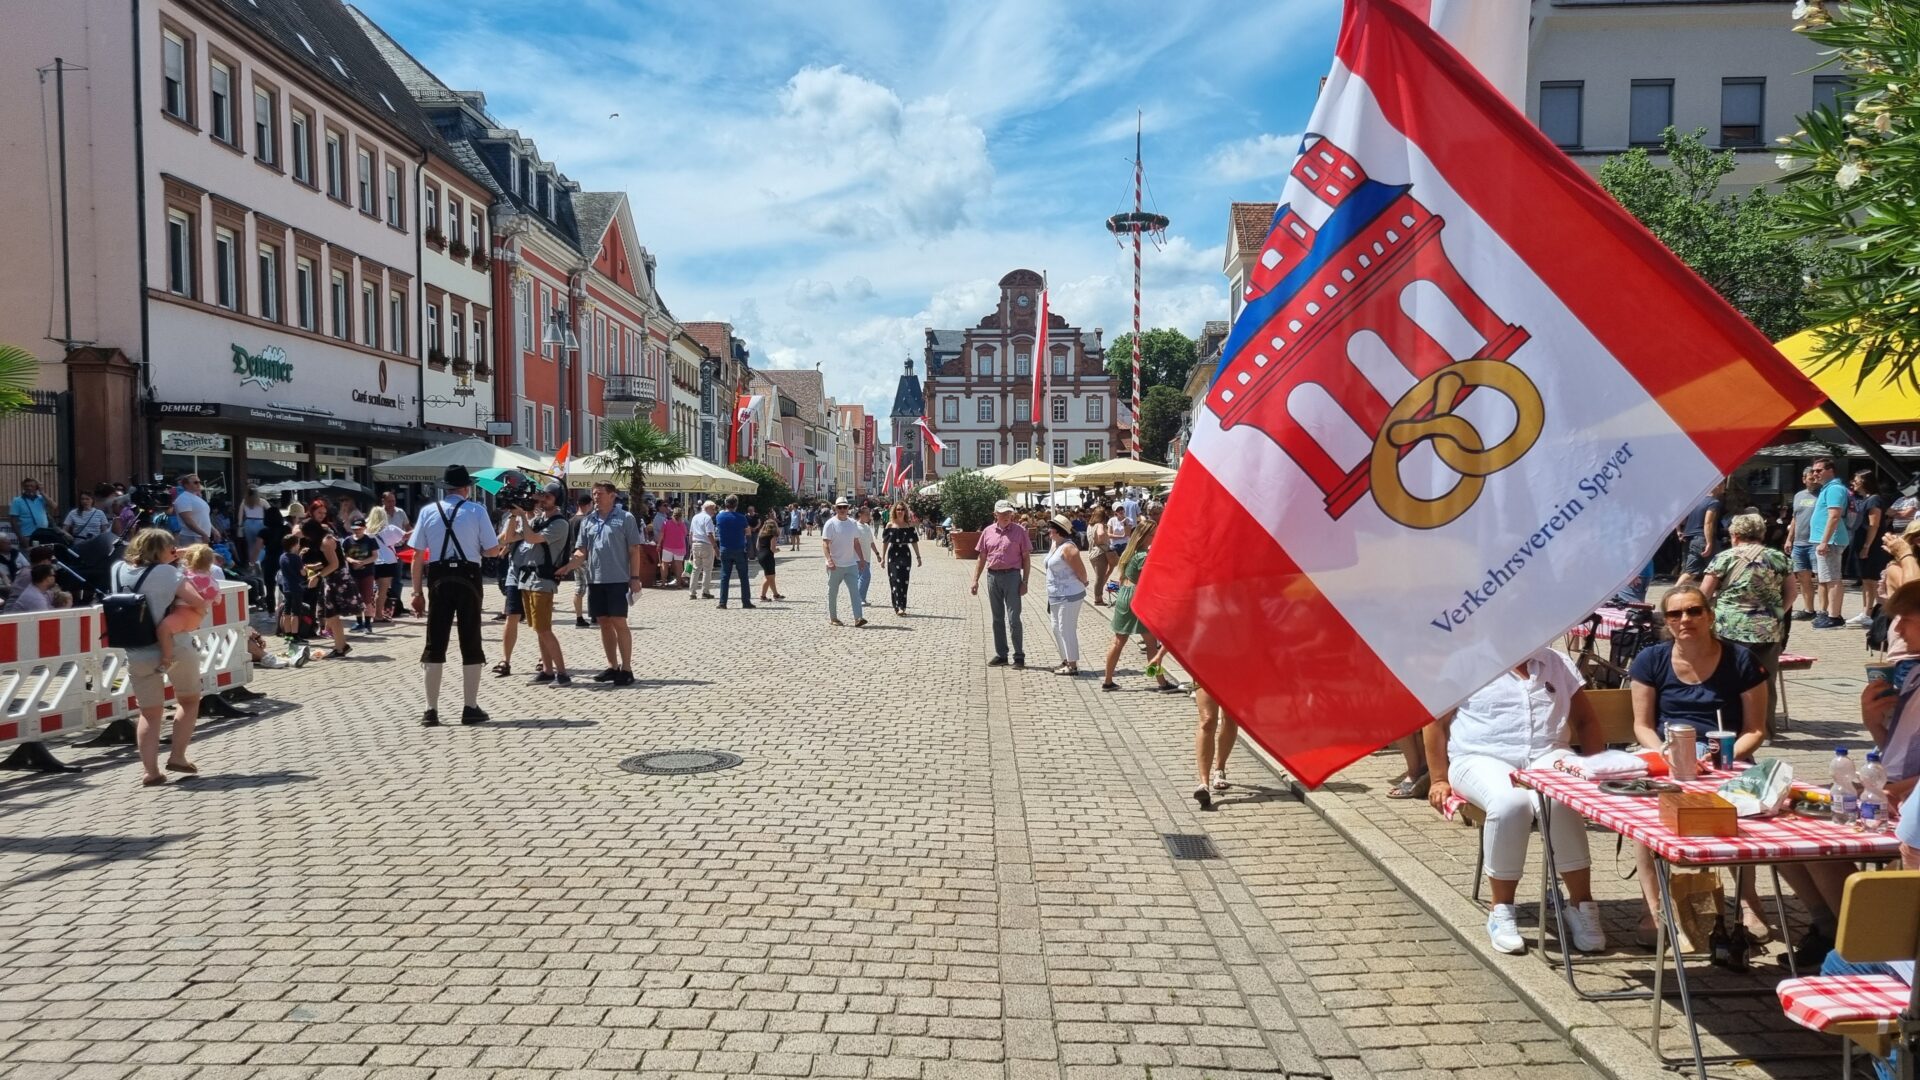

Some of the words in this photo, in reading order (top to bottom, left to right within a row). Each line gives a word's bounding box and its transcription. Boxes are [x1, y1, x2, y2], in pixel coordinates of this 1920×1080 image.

[160, 404, 202, 412] DEMMER
[703, 429, 711, 460] LTURHOF
[388, 473, 437, 481] KONDITOREI
[1430, 498, 1584, 634] Verkehrsverein
[1578, 442, 1634, 500] Speyer
